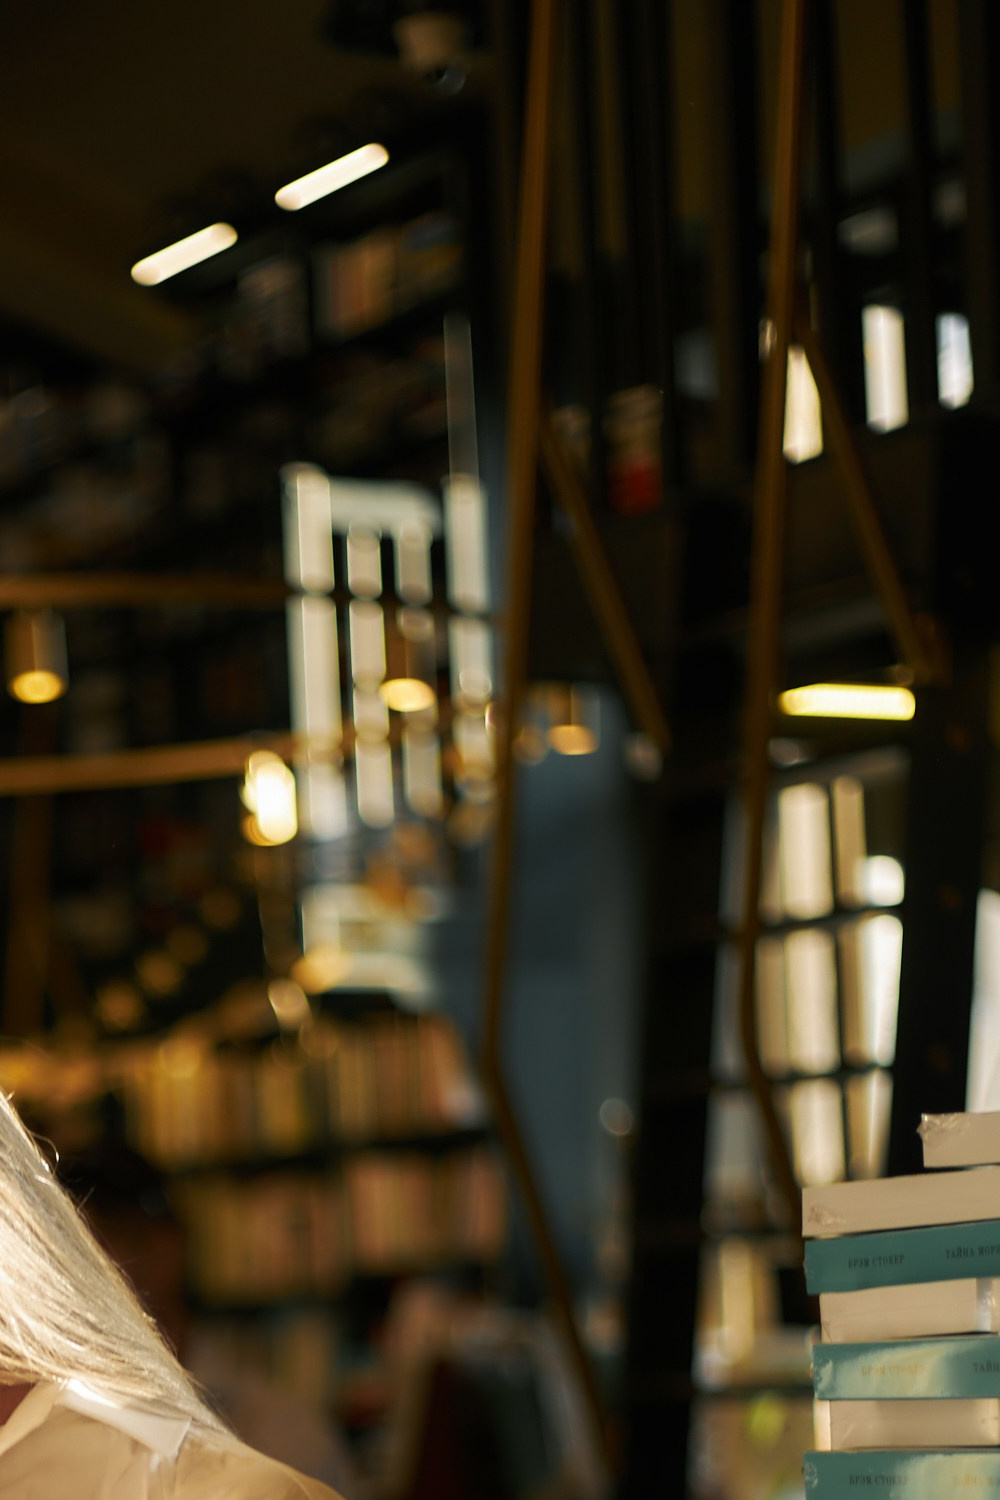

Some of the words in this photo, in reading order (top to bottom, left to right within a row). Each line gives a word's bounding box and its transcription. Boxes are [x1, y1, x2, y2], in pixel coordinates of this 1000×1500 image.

[945, 1245, 976, 1260] ТАЙНА
[848, 1257, 870, 1270] БРЭМ
[872, 1254, 905, 1268] СТОКЕР
[972, 1359, 1000, 1374] ТАЙН
[849, 1473, 873, 1486] БРЭМ
